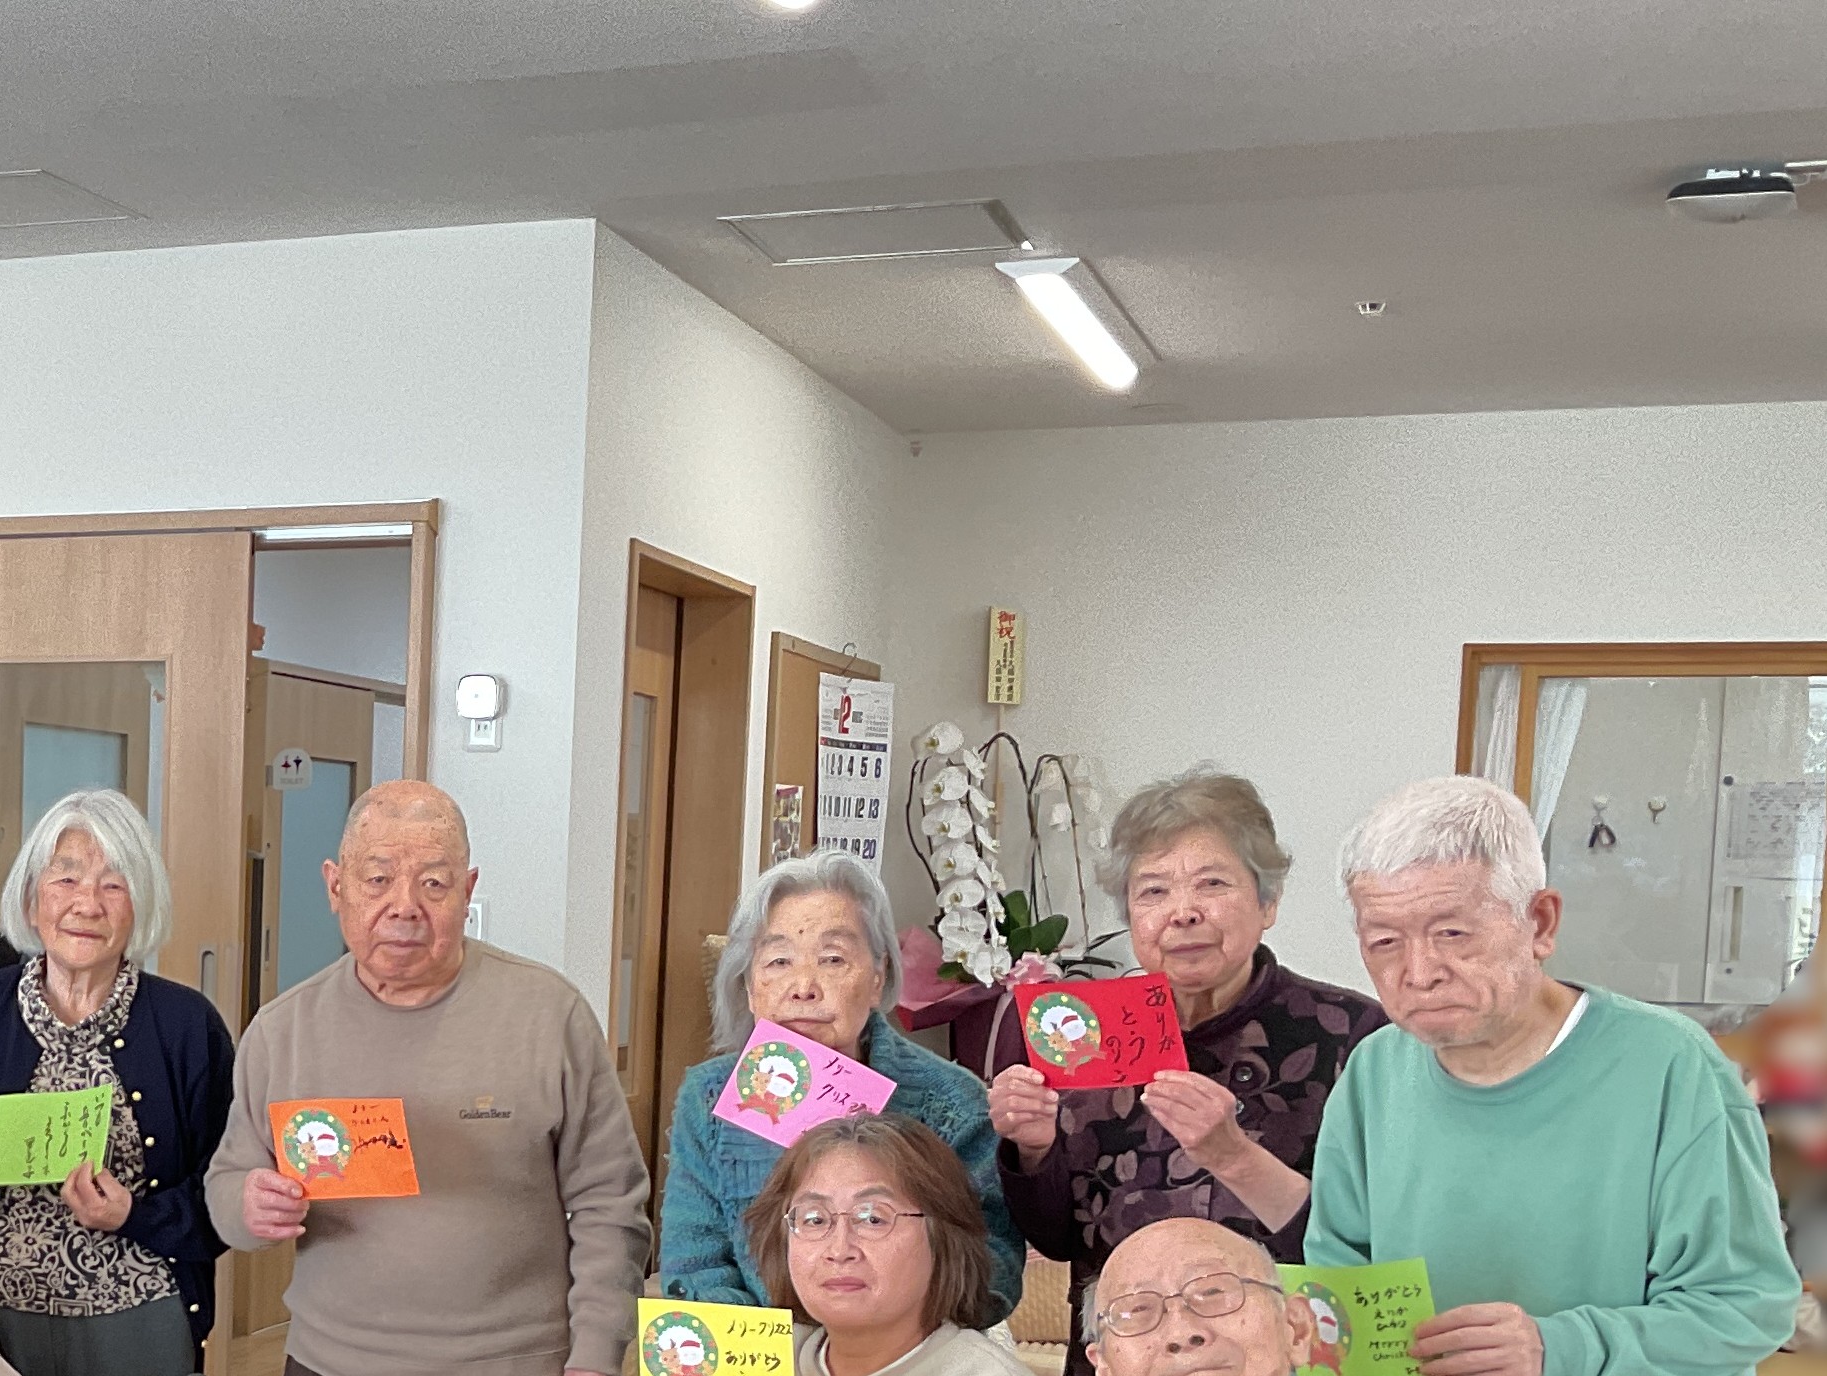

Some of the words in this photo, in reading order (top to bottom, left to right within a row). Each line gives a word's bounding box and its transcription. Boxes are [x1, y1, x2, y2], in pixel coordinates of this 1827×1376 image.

[847, 756, 854, 777] 4
[860, 756, 868, 778] 5
[874, 757, 882, 778] 6
[855, 798, 865, 818] 12
[868, 798, 880, 818] 13
[862, 838, 877, 859] 20
